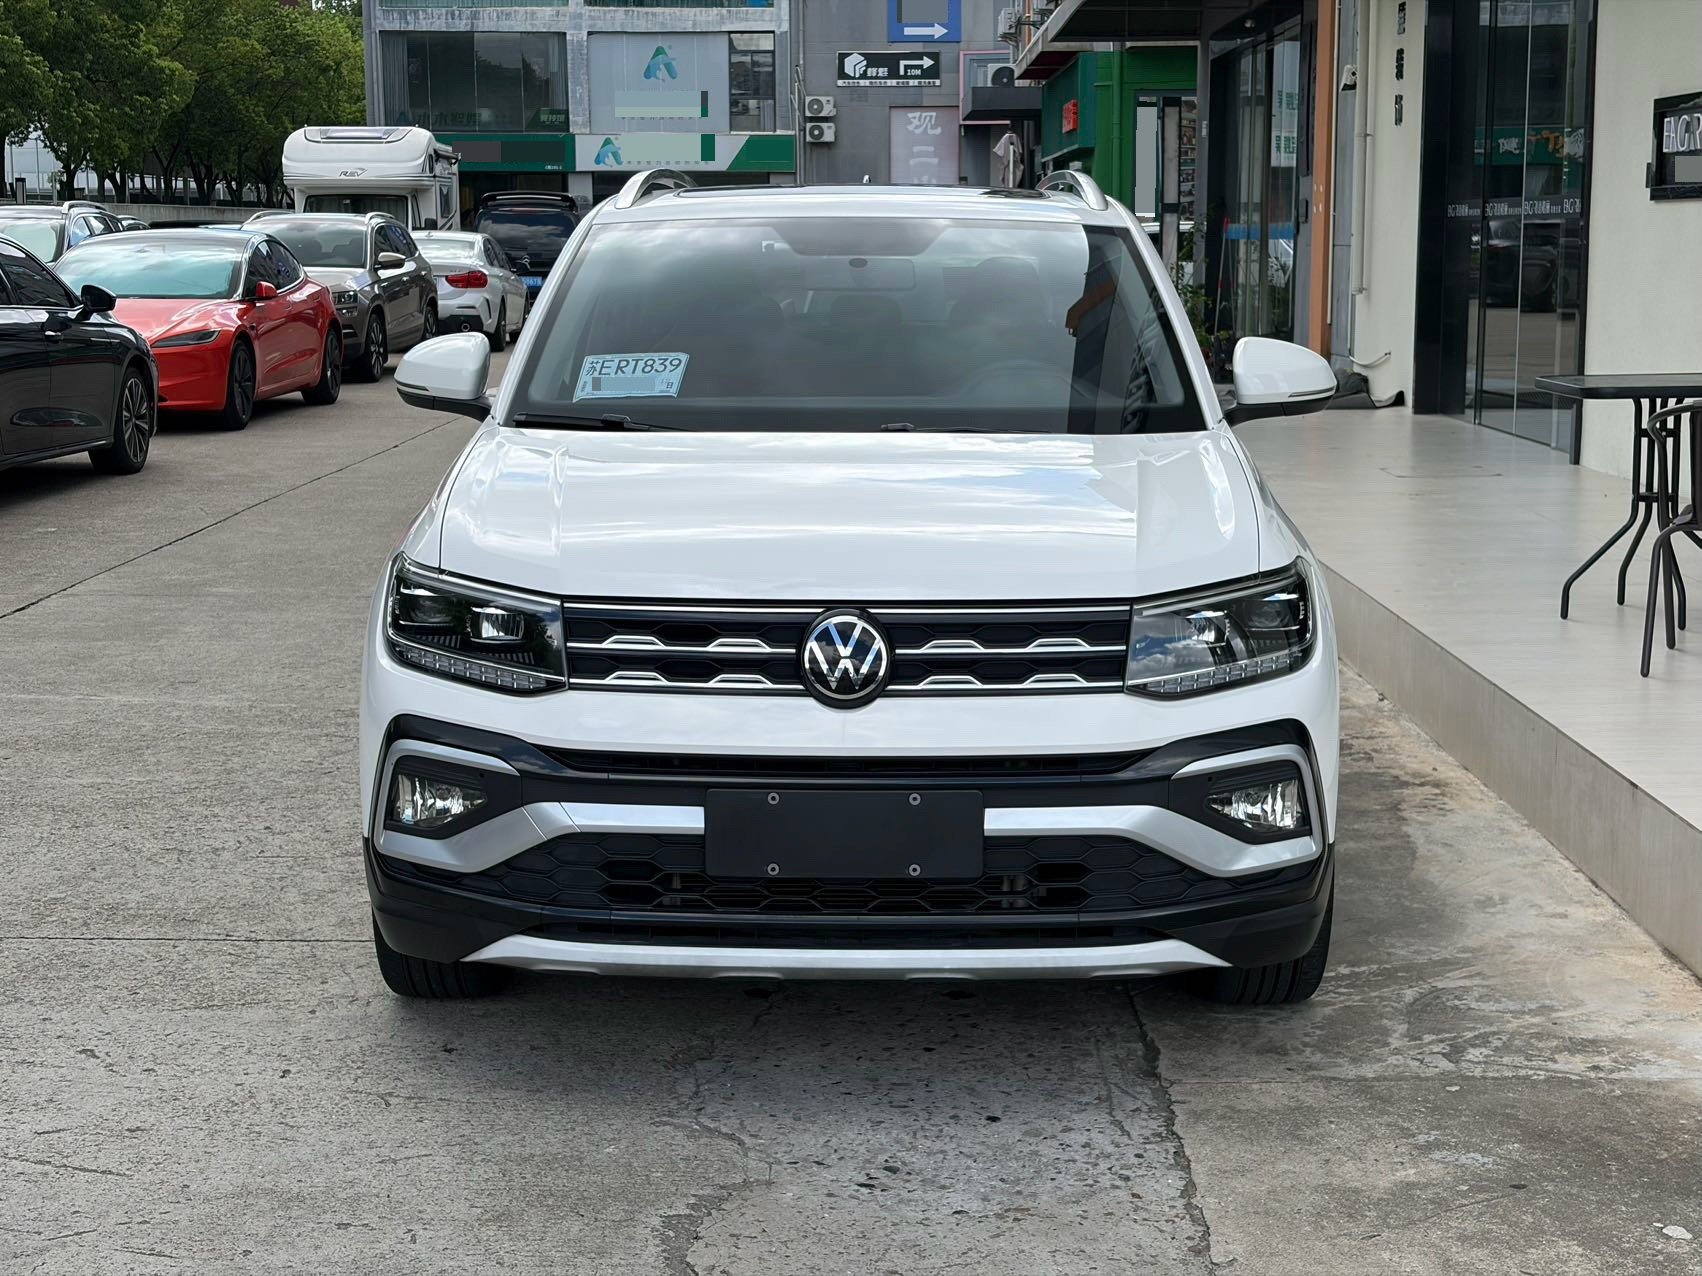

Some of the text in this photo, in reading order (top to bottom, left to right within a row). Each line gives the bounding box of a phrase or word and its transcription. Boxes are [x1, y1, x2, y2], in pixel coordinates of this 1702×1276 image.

[906, 68, 922, 76] 10M
[585, 357, 682, 376] 苏ERT839
[807, 619, 882, 691] VW
